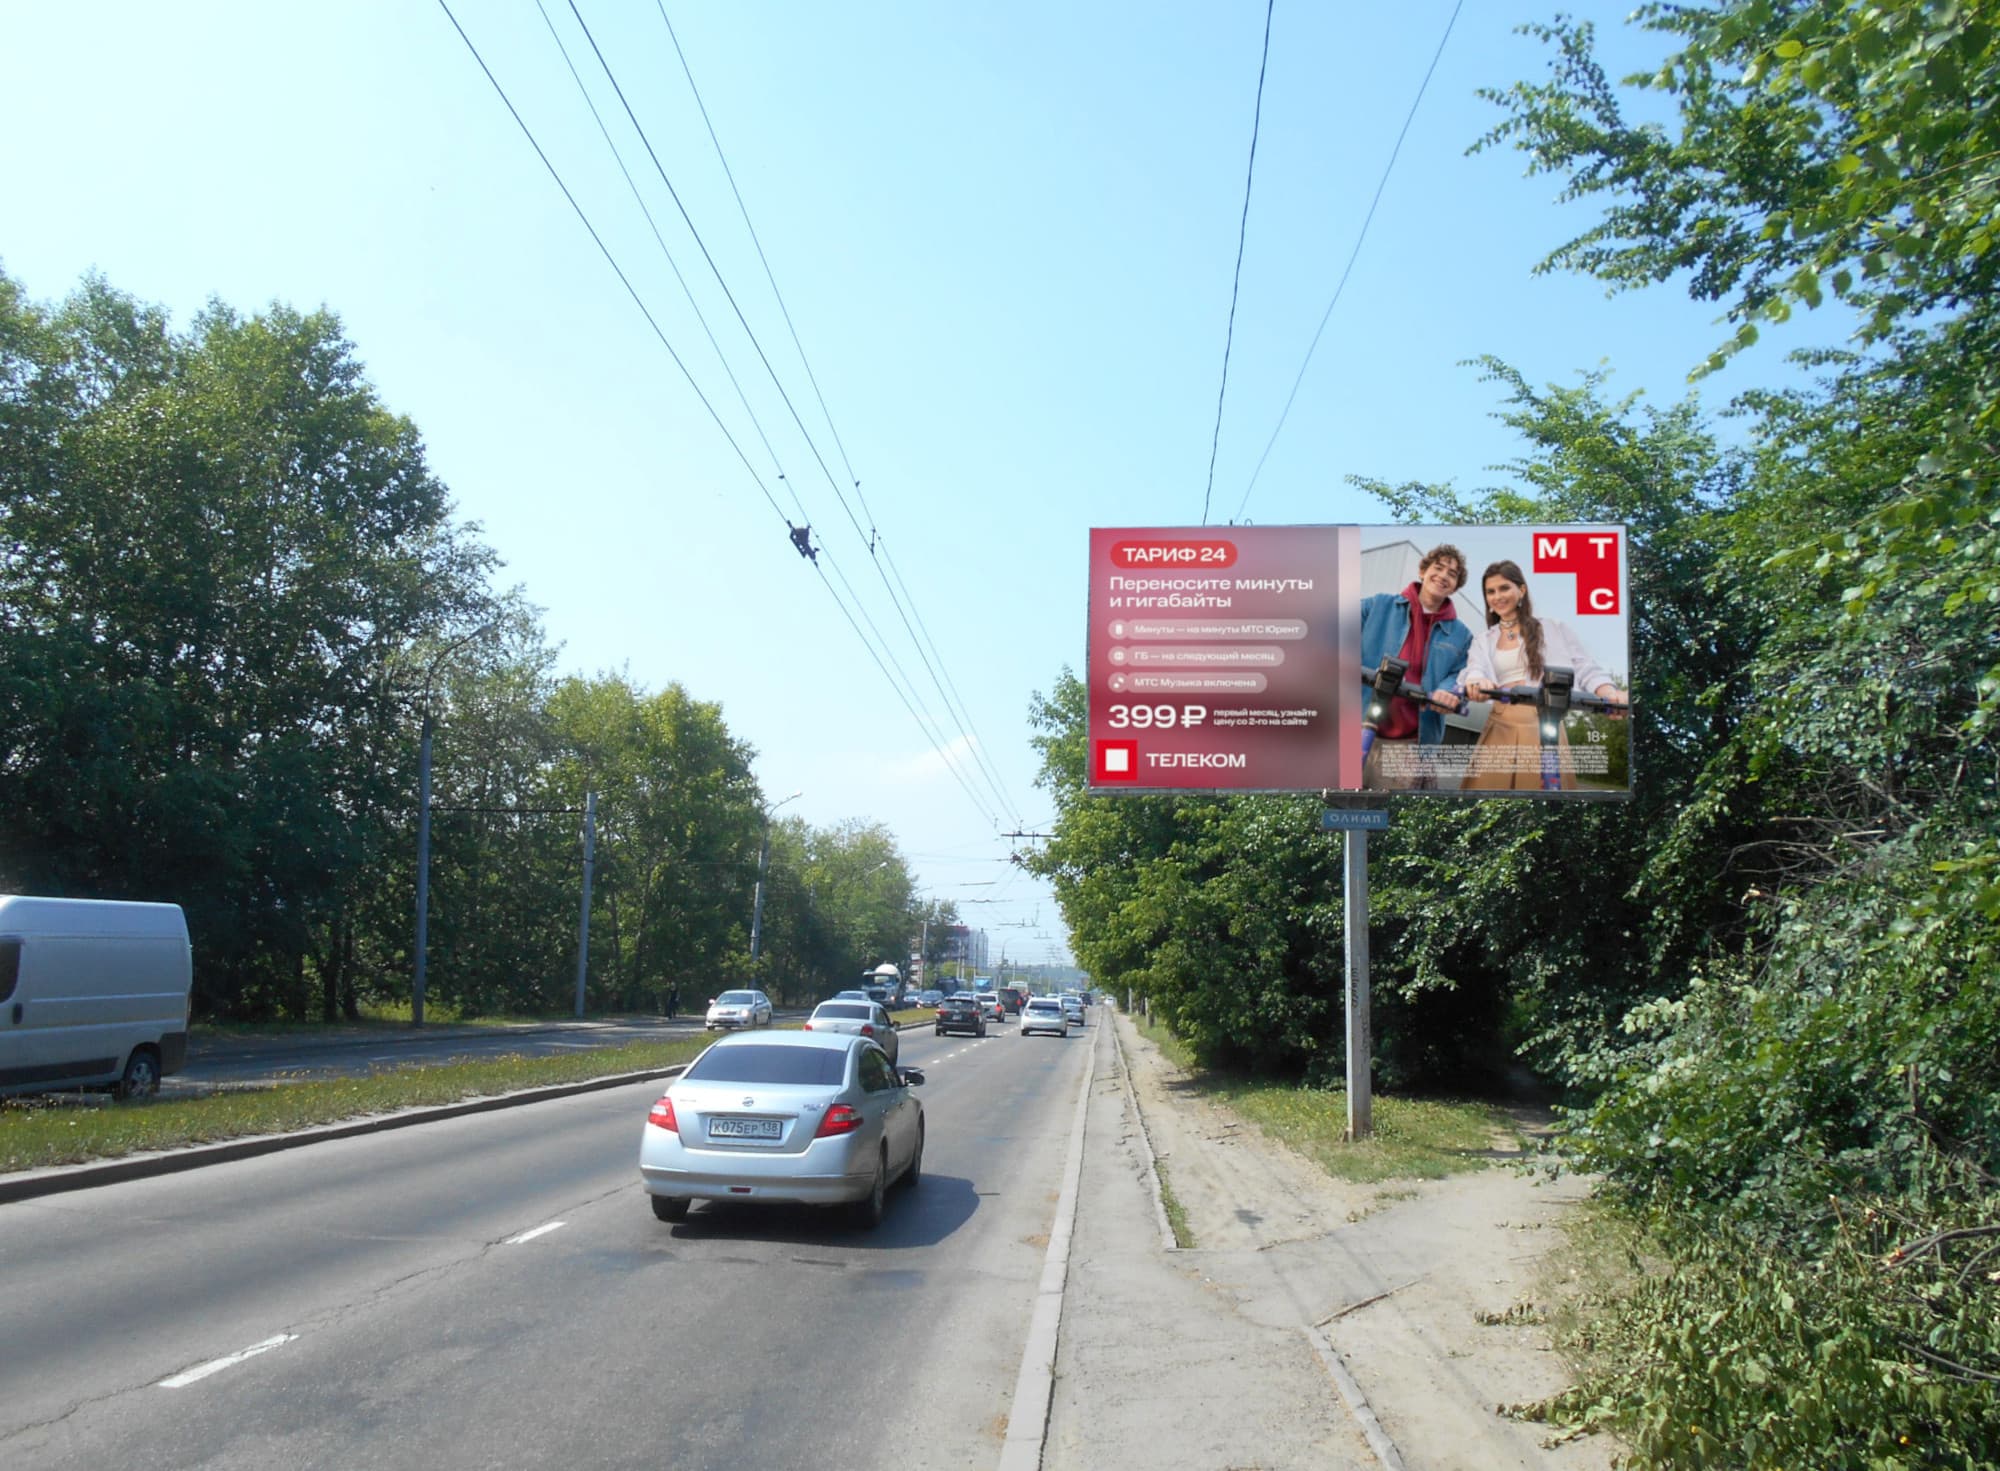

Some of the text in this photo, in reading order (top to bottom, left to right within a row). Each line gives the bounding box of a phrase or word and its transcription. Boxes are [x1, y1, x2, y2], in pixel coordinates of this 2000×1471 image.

[1123, 547, 1226, 562] ТАРИФ 24
[1110, 577, 1313, 593] Переносите минуты
[1110, 594, 1232, 608] и гигабайты
[1241, 625, 1264, 634] МТС
[1134, 679, 1159, 687] МТС
[1108, 705, 1176, 729] 399
[1587, 731, 1608, 742] 18+
[1146, 753, 1246, 768] ТЕЛЕКОМ
